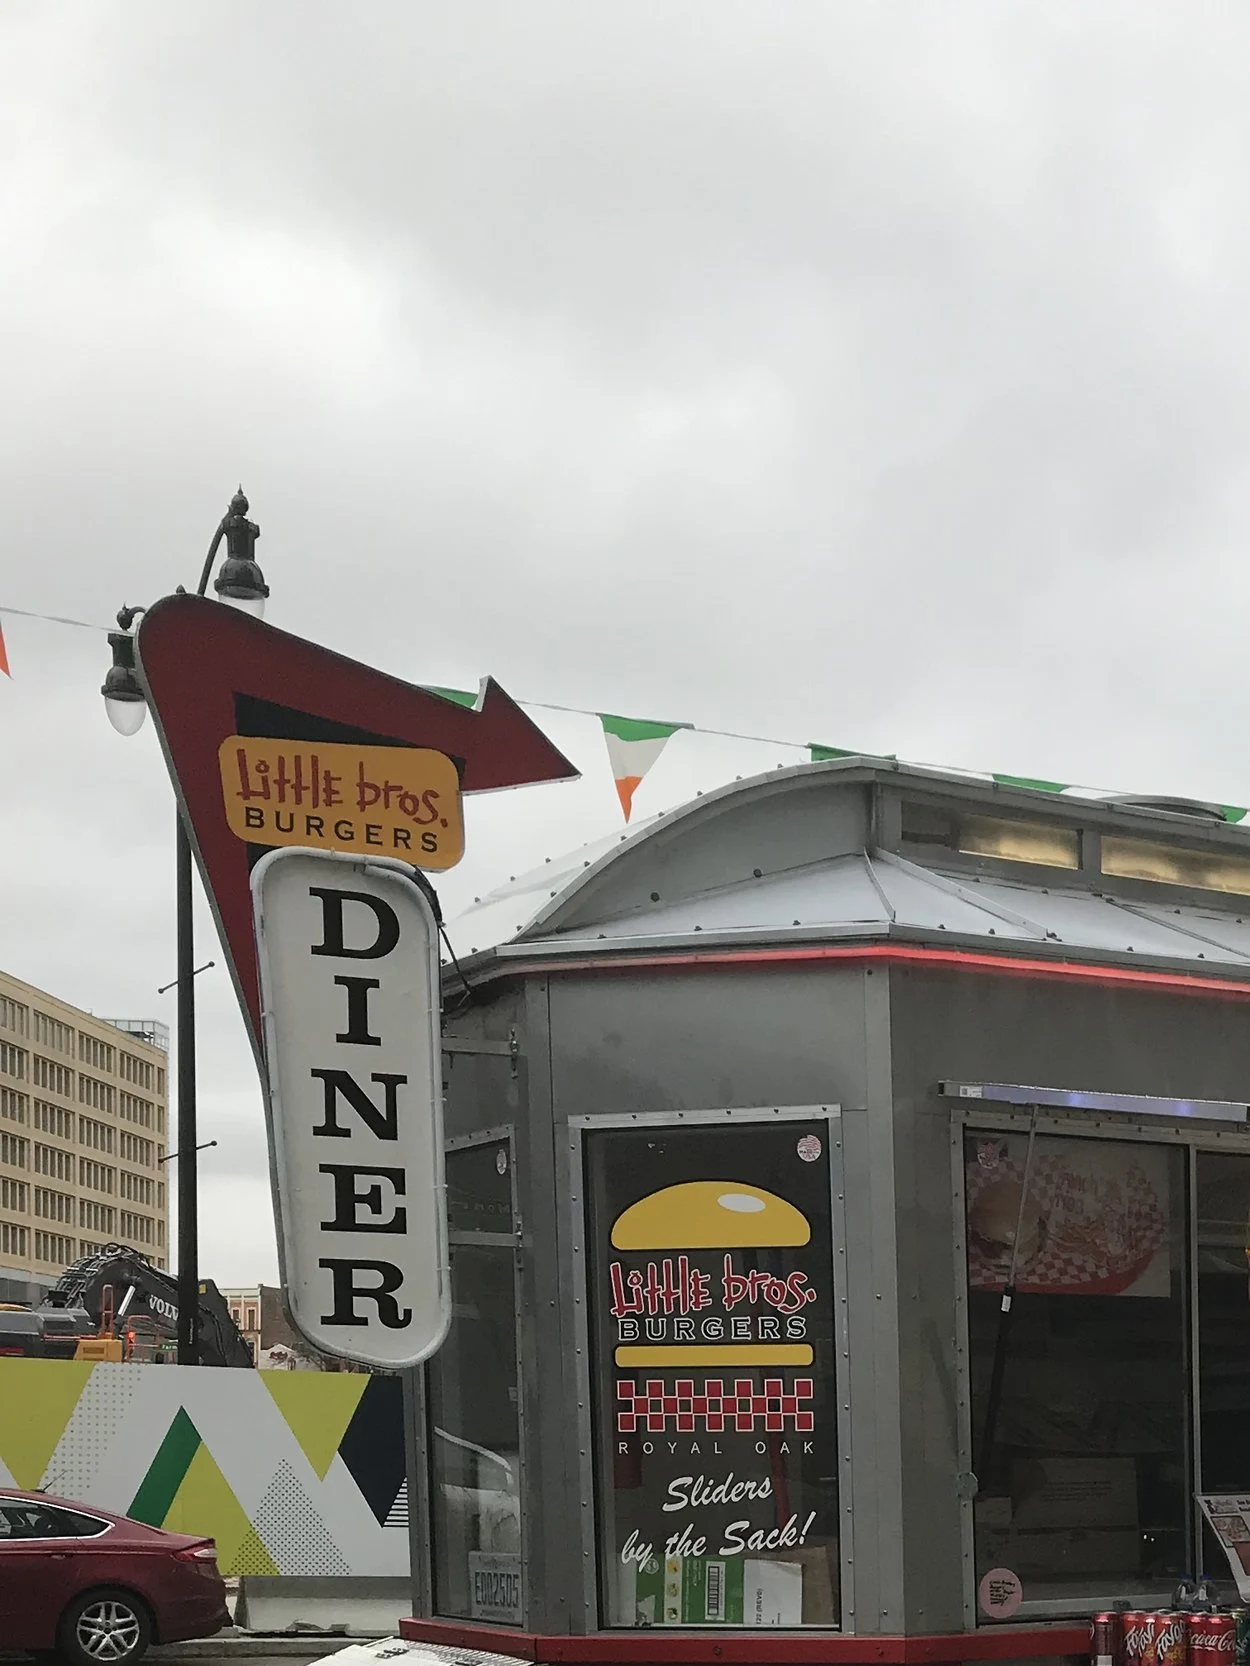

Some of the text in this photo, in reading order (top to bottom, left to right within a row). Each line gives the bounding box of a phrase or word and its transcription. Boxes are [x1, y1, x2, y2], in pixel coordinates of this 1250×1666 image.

[244, 806, 438, 853] BURGERS
[308, 887, 412, 1331] DINER
[149, 1293, 178, 1321] VOLV
[617, 1316, 807, 1341] BURGERS
[618, 1441, 814, 1455] ROYAL OAK
[661, 1472, 774, 1512] Sliders
[621, 1528, 653, 1573] by
[664, 1523, 707, 1560] the
[718, 1511, 816, 1556] Sack!
